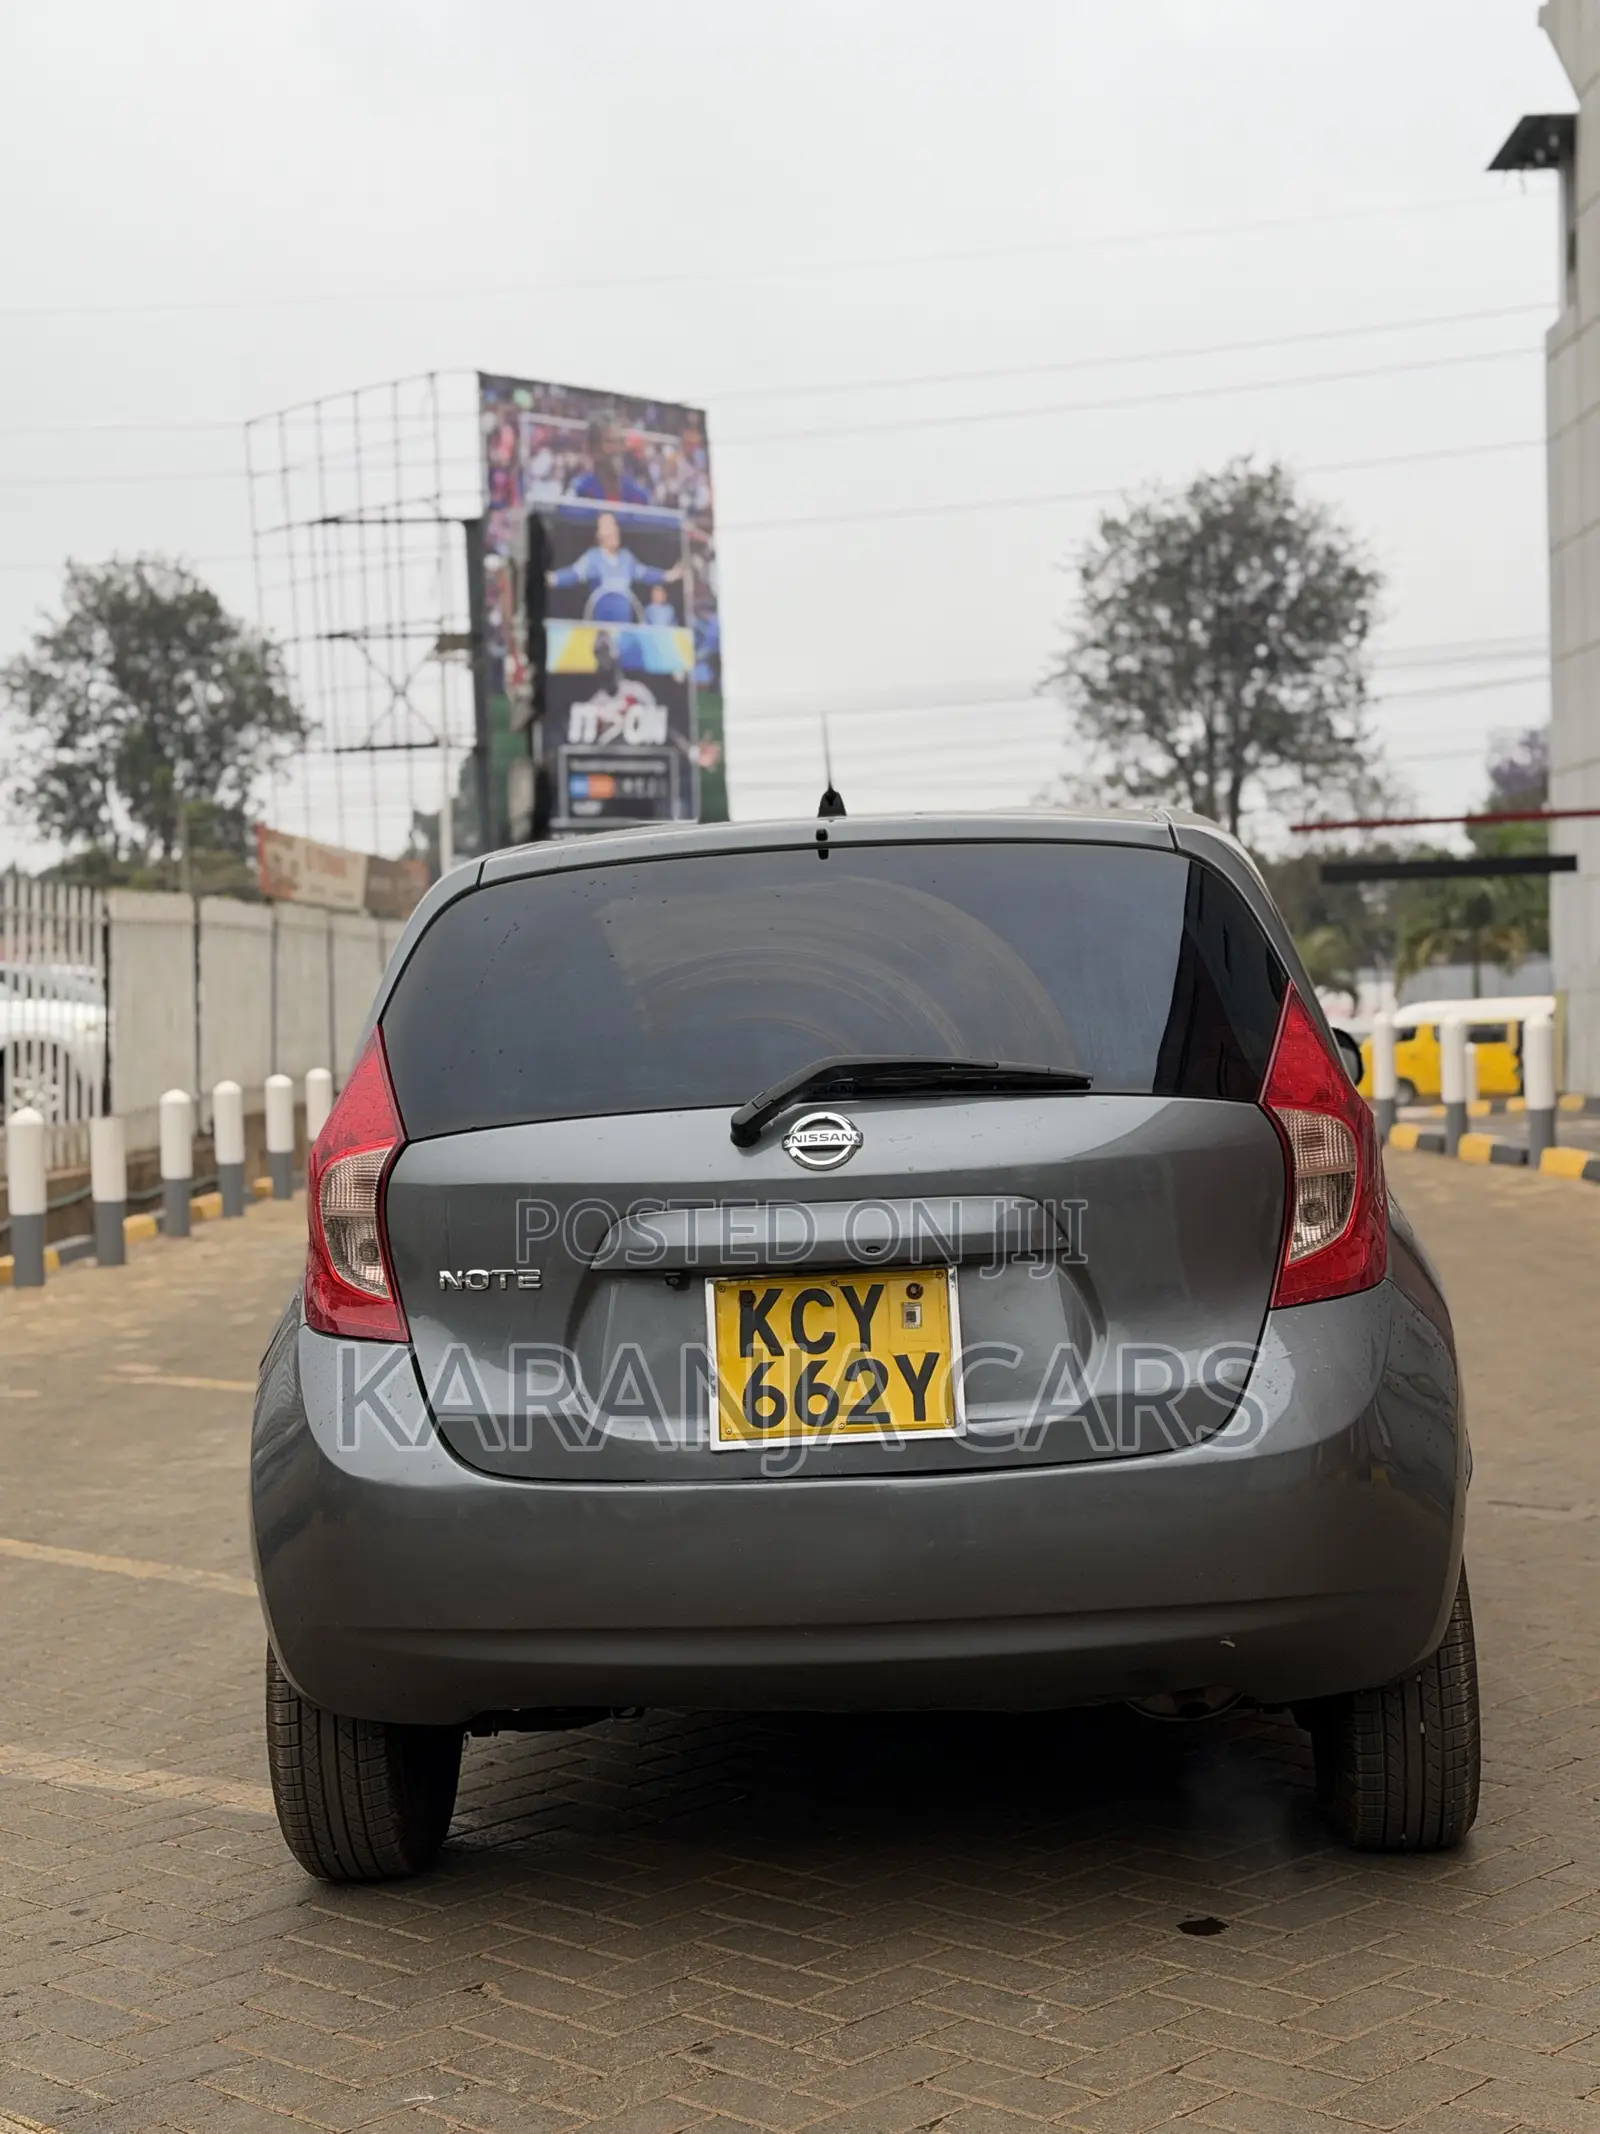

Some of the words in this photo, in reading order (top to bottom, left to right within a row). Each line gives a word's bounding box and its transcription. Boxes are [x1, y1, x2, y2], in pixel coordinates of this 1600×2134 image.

[791, 1132, 853, 1144] NISSAN
[438, 1268, 542, 1291] NOTE
[739, 1284, 885, 1358] KCY
[742, 1352, 940, 1430] 662Y
